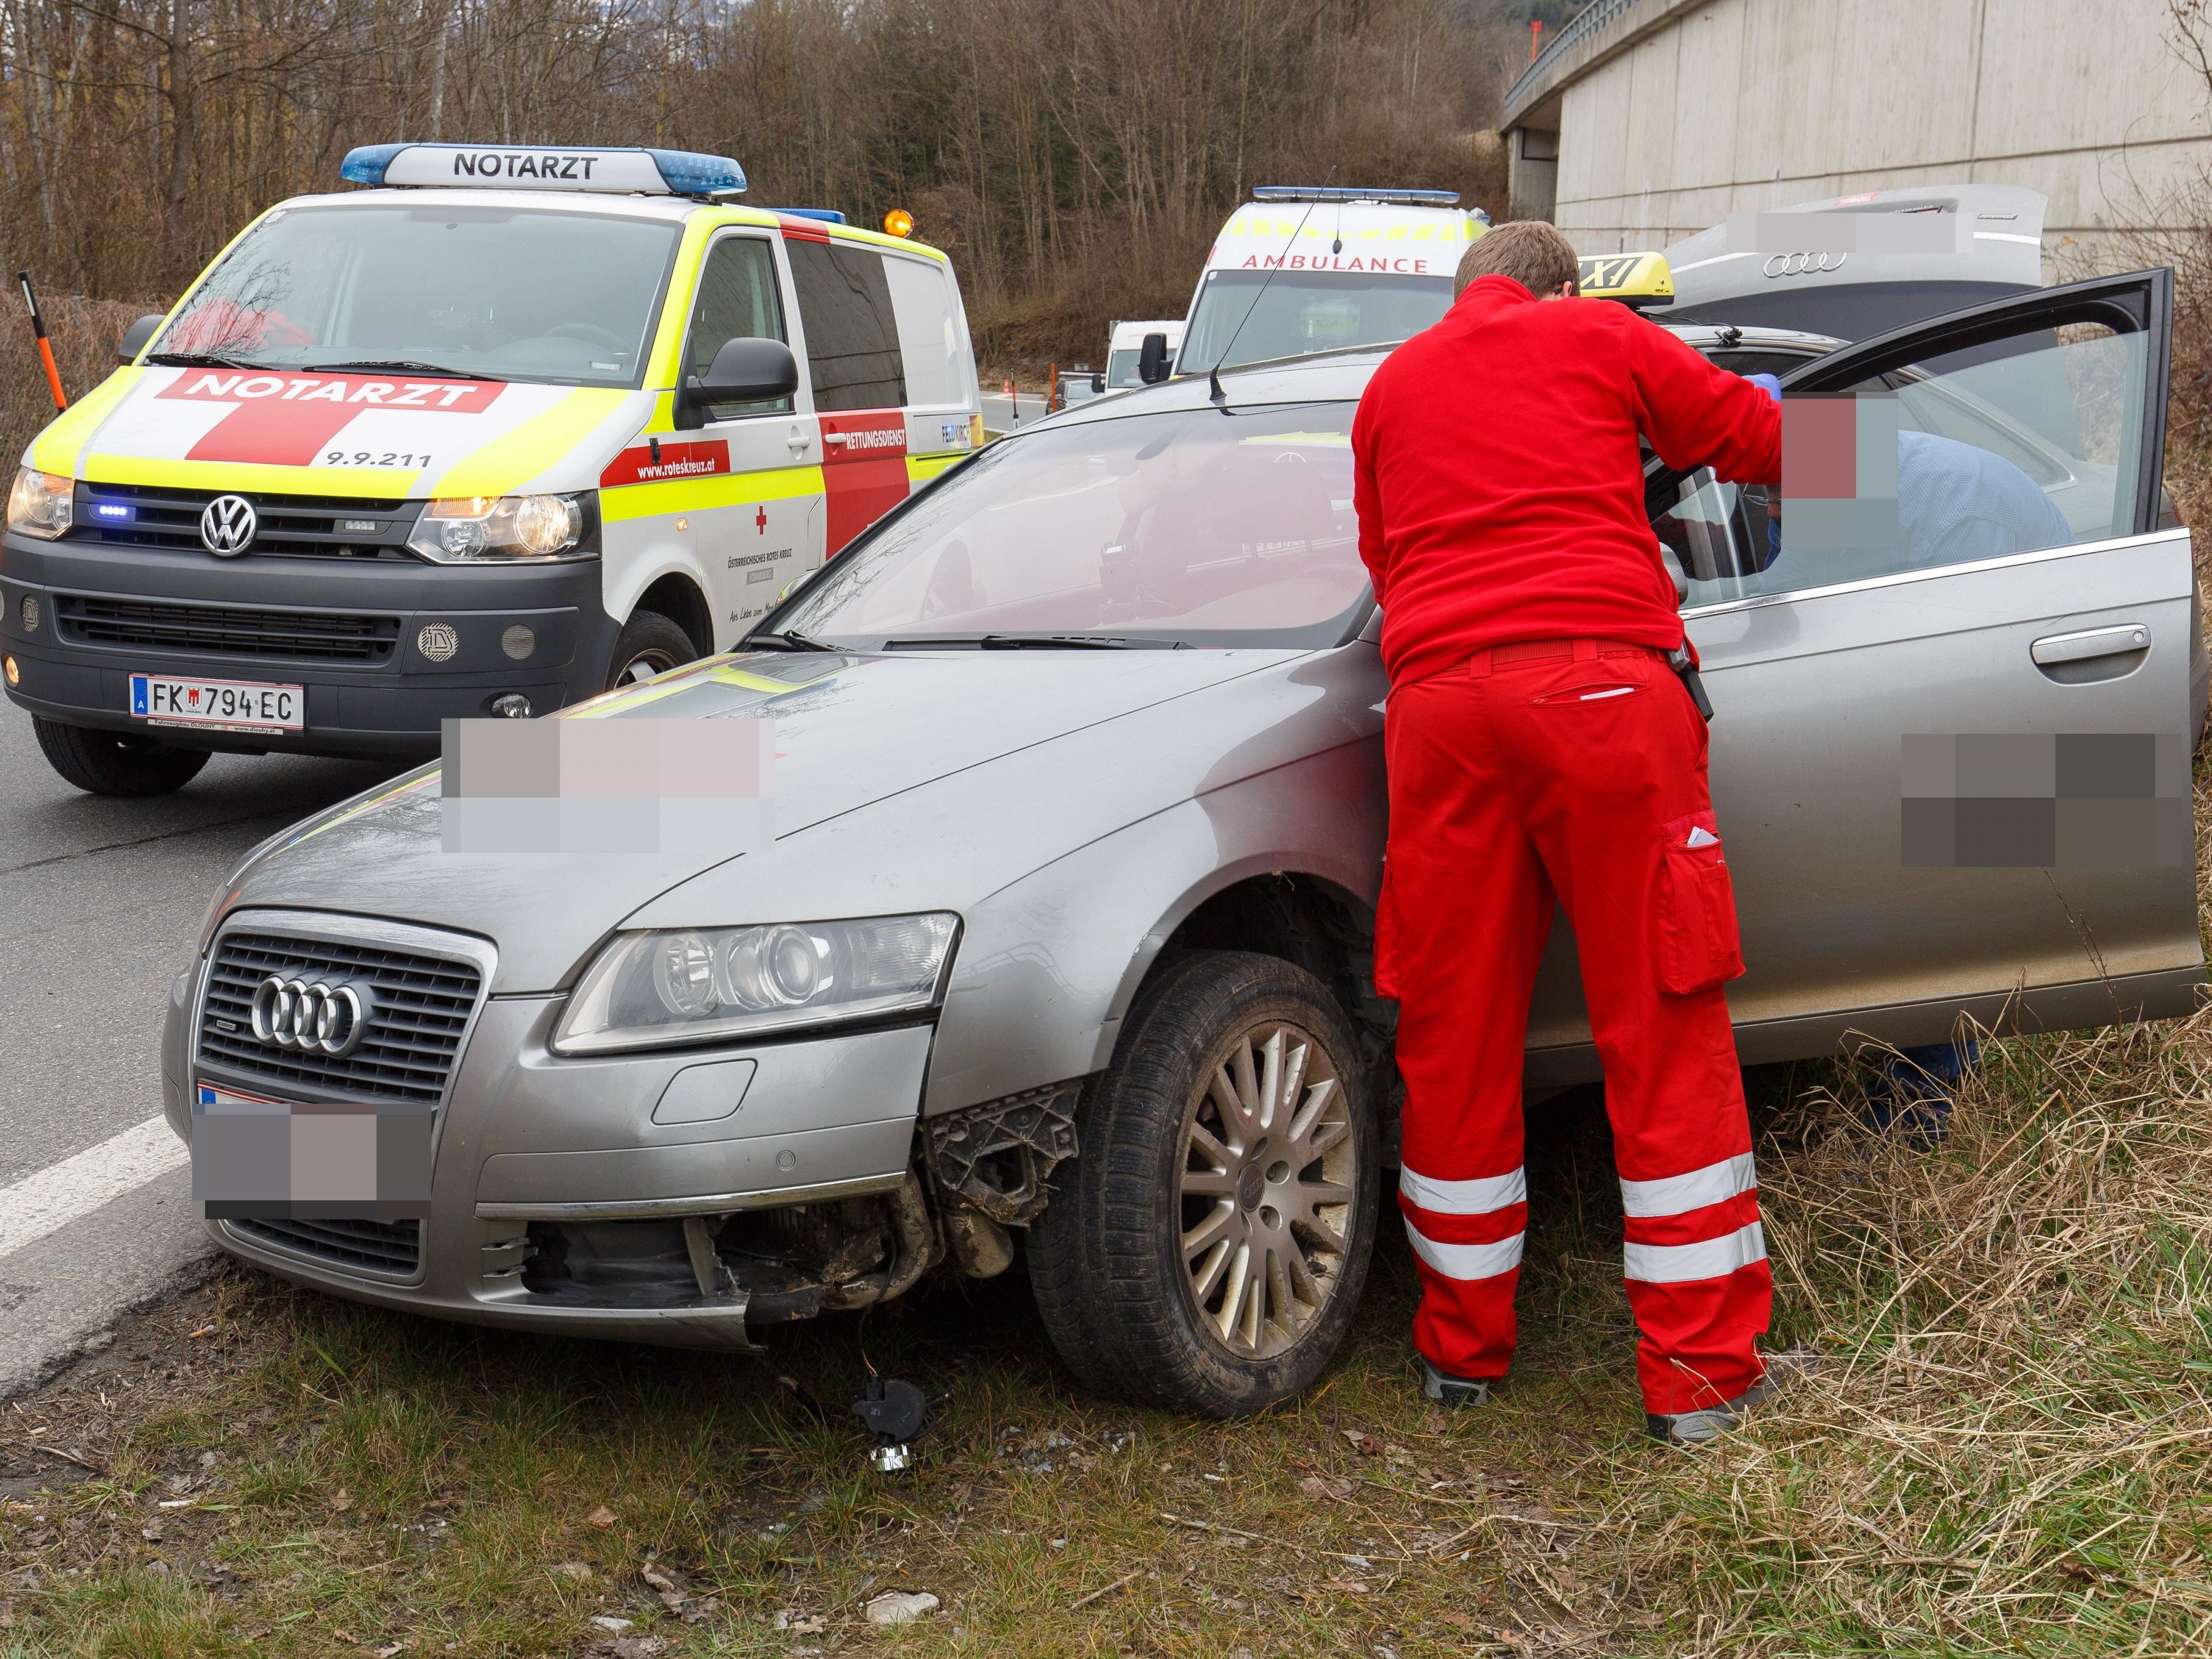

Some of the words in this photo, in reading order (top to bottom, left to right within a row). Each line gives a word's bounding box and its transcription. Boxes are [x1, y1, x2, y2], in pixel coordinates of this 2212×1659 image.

[454, 154, 598, 180] NOTARZT
[1241, 255, 1428, 273] AMBULANCE
[1580, 259, 1636, 288] XI
[184, 374, 478, 407] NOTARZT
[846, 429, 905, 450] RETTUNGSDIENST
[326, 451, 433, 468] 9.9.211
[637, 457, 715, 479] www.roteskreuz.at
[728, 553, 765, 569] ÖSTERREICHISCHES
[766, 551, 779, 561] ROTES
[779, 548, 792, 559] KREUZ
[730, 610, 738, 623] Aus
[740, 607, 752, 620] Liebe
[137, 700, 145, 710] A
[153, 683, 183, 713] FK
[205, 687, 252, 718] 794
[261, 690, 292, 720] EC
